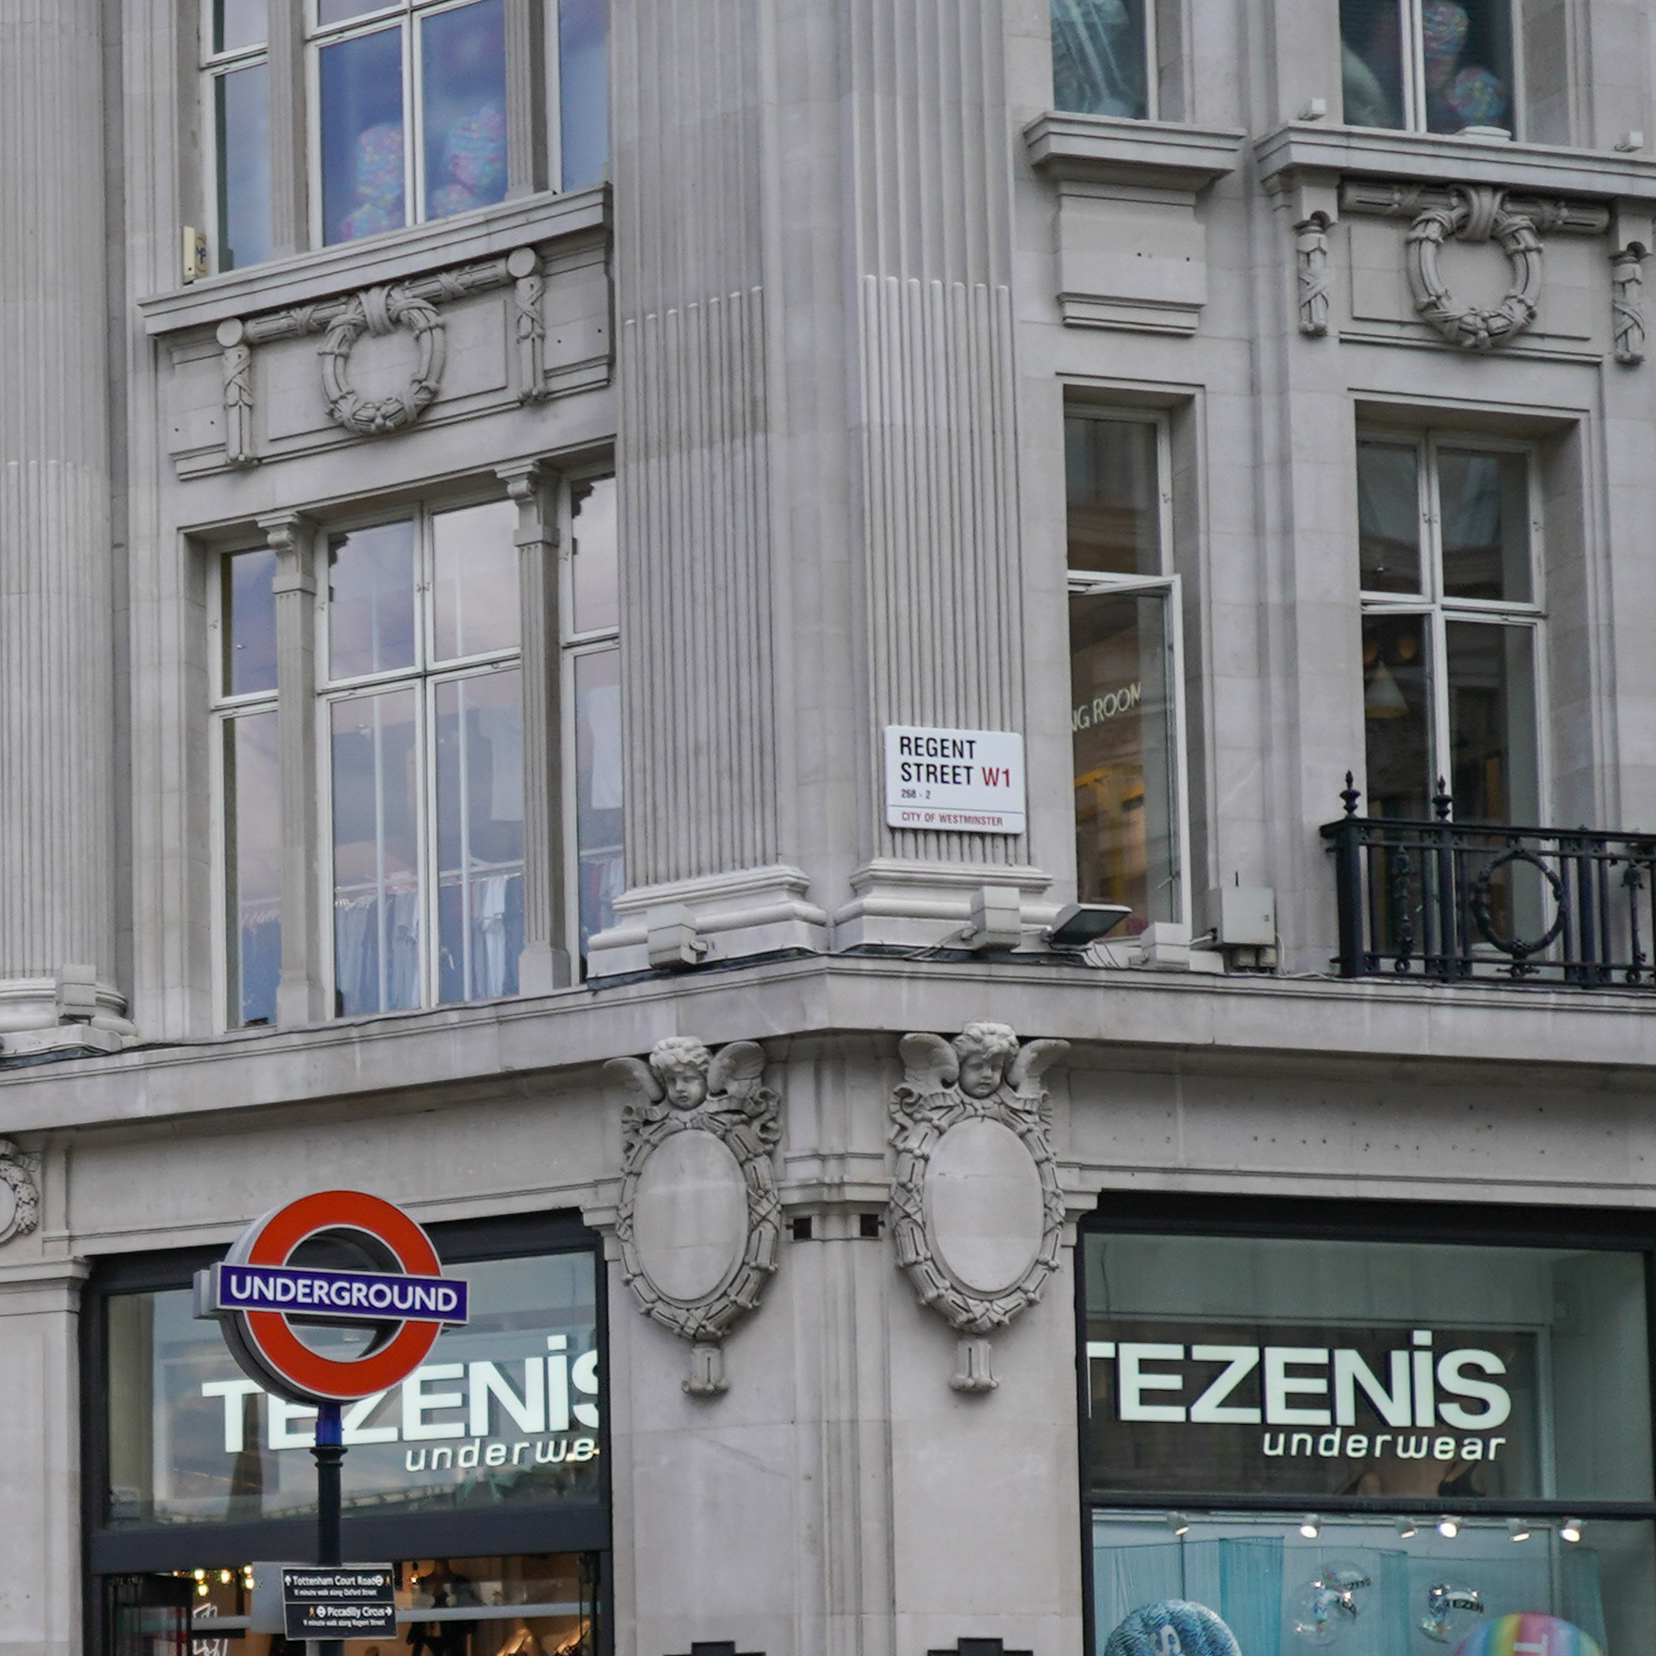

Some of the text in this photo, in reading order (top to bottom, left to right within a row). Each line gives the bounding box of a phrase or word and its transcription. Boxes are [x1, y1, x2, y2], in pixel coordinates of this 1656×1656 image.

[899, 736, 977, 760] REGENT
[900, 761, 1011, 788] STREET W1
[901, 811, 1004, 827] CITY OF WESTMINSTER
[230, 1274, 458, 1312] UNDERGROUND
[1263, 1429, 1506, 1461] underwear
[292, 1575, 334, 1586] Tottenham
[334, 1575, 356, 1586] Court
[327, 1606, 385, 1618] Piccadilly Circus
